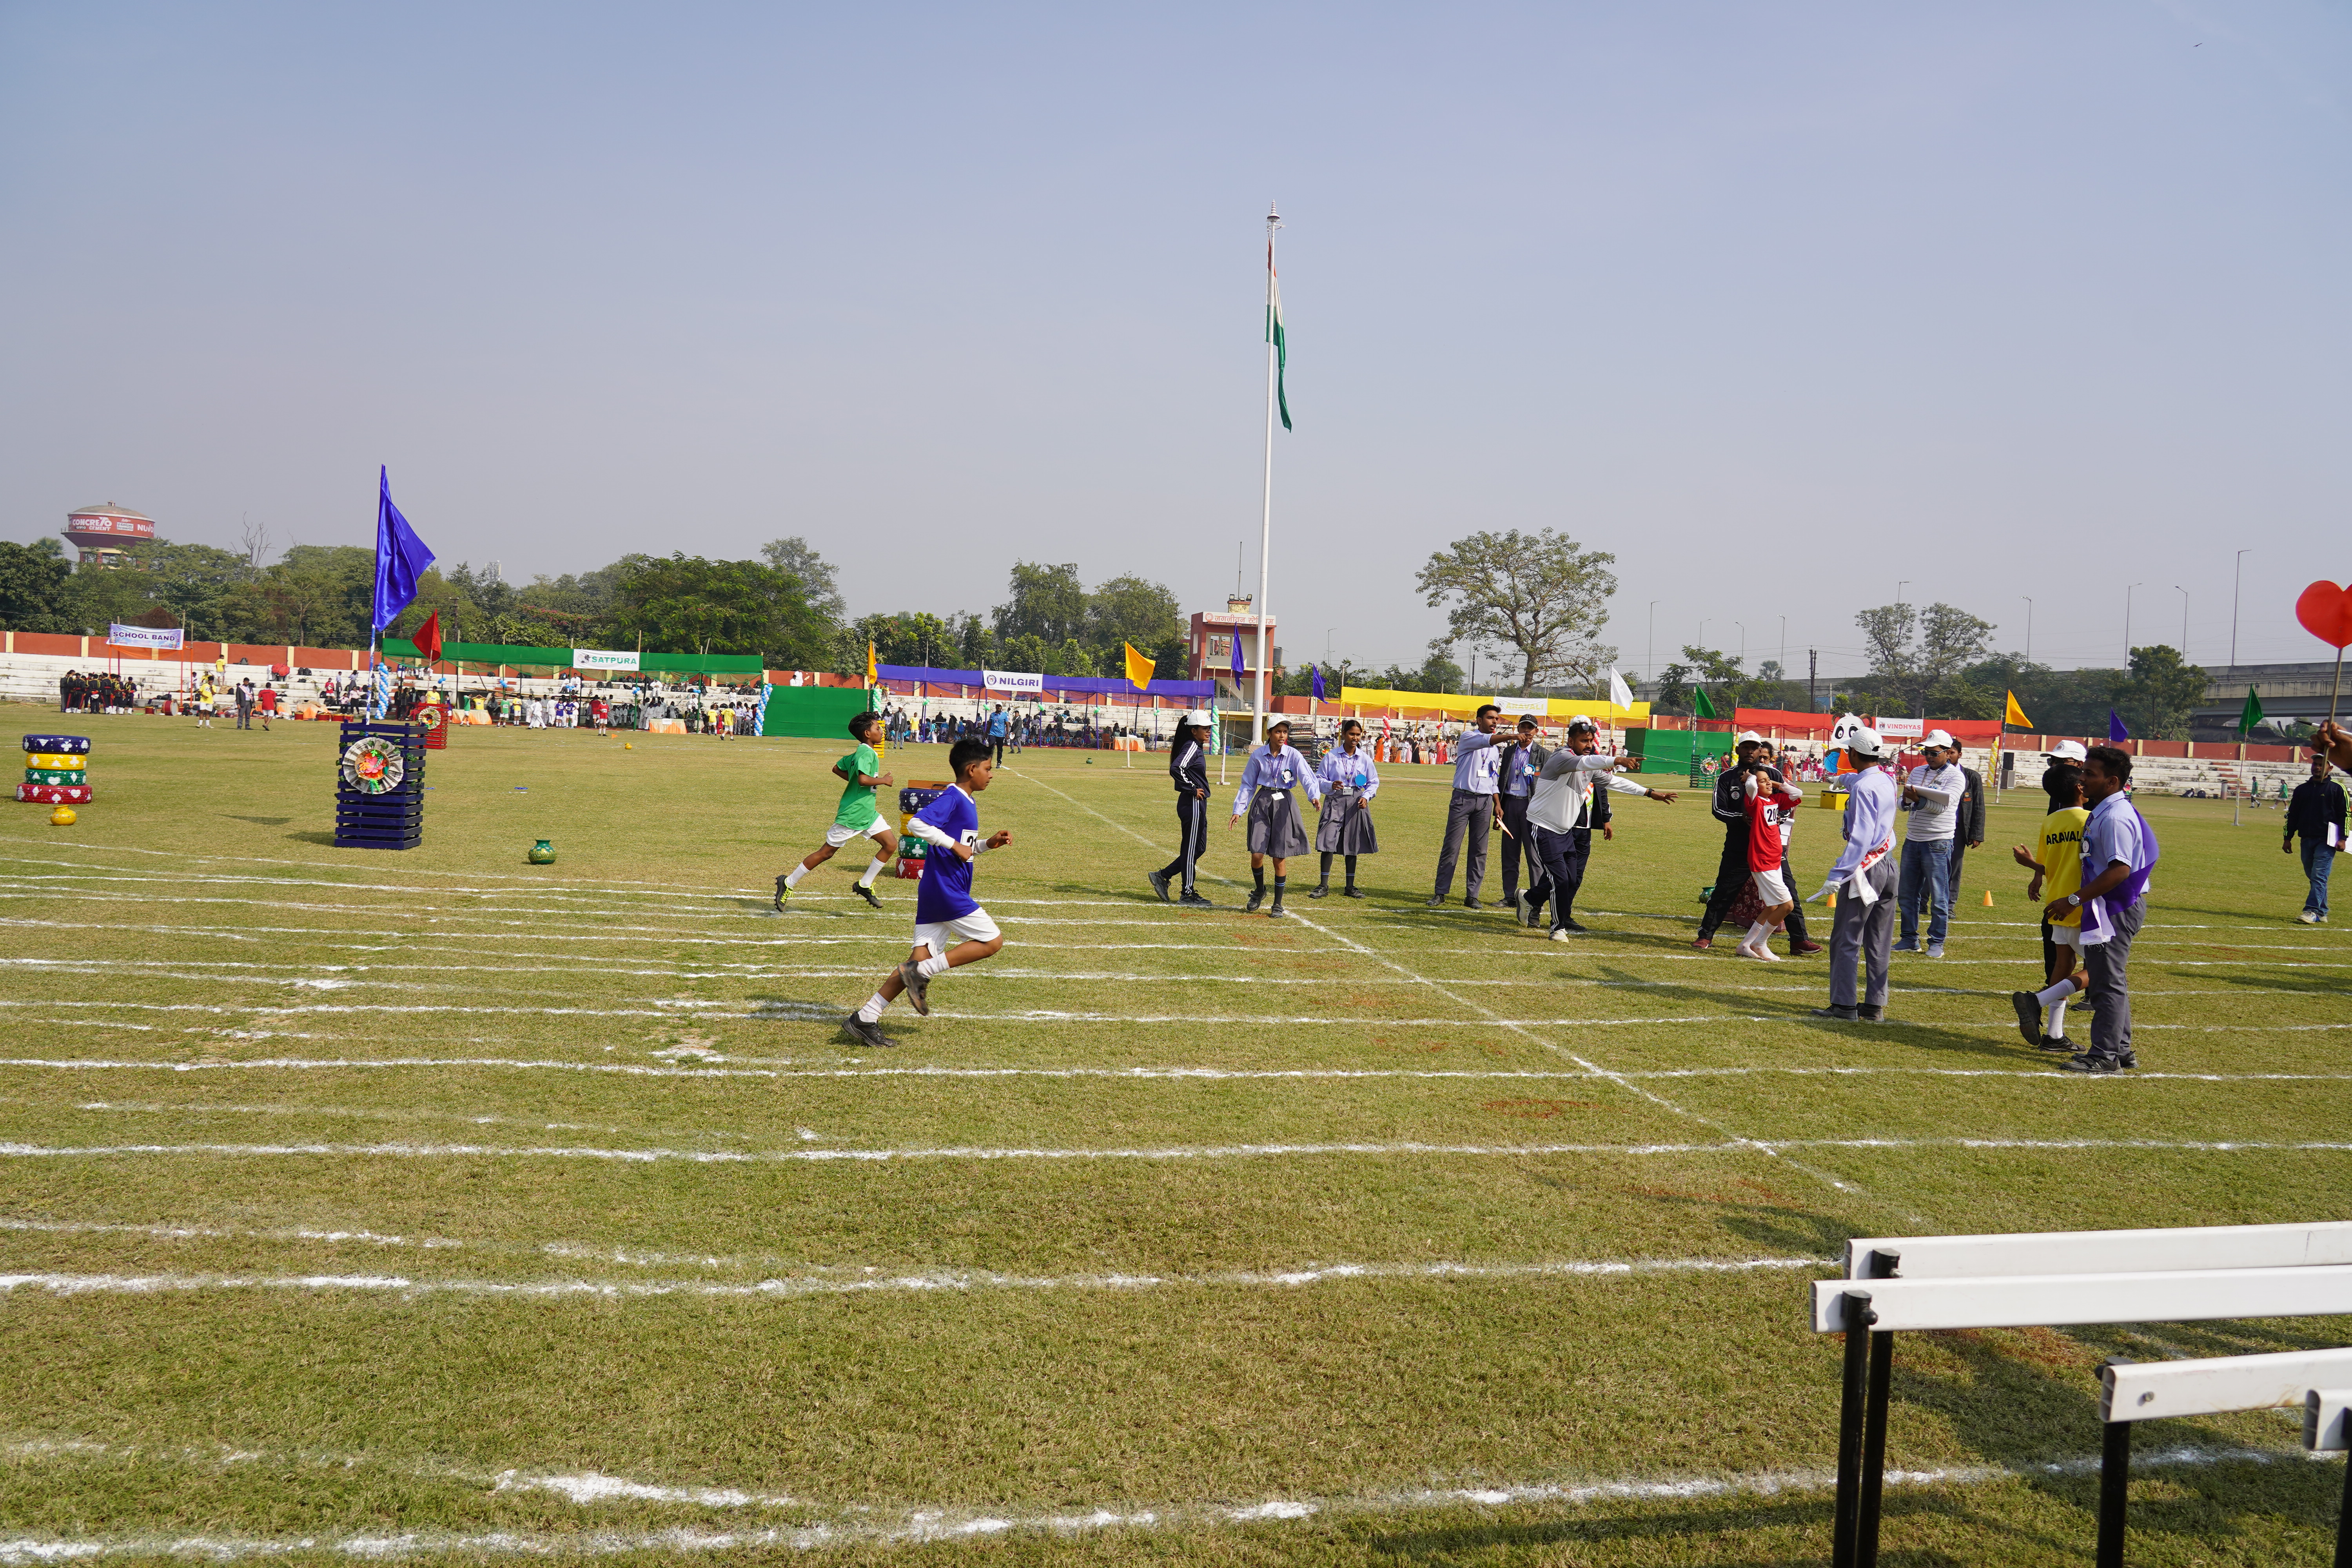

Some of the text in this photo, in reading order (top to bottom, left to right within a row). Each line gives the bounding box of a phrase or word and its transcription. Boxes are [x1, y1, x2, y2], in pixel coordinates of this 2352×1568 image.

[73, 517, 112, 527] CONCRETO
[1214, 614, 1246, 623] जगजीवन
[1000, 677, 1039, 686] NILGIRI
[2047, 831, 2081, 845] ARAVAL
